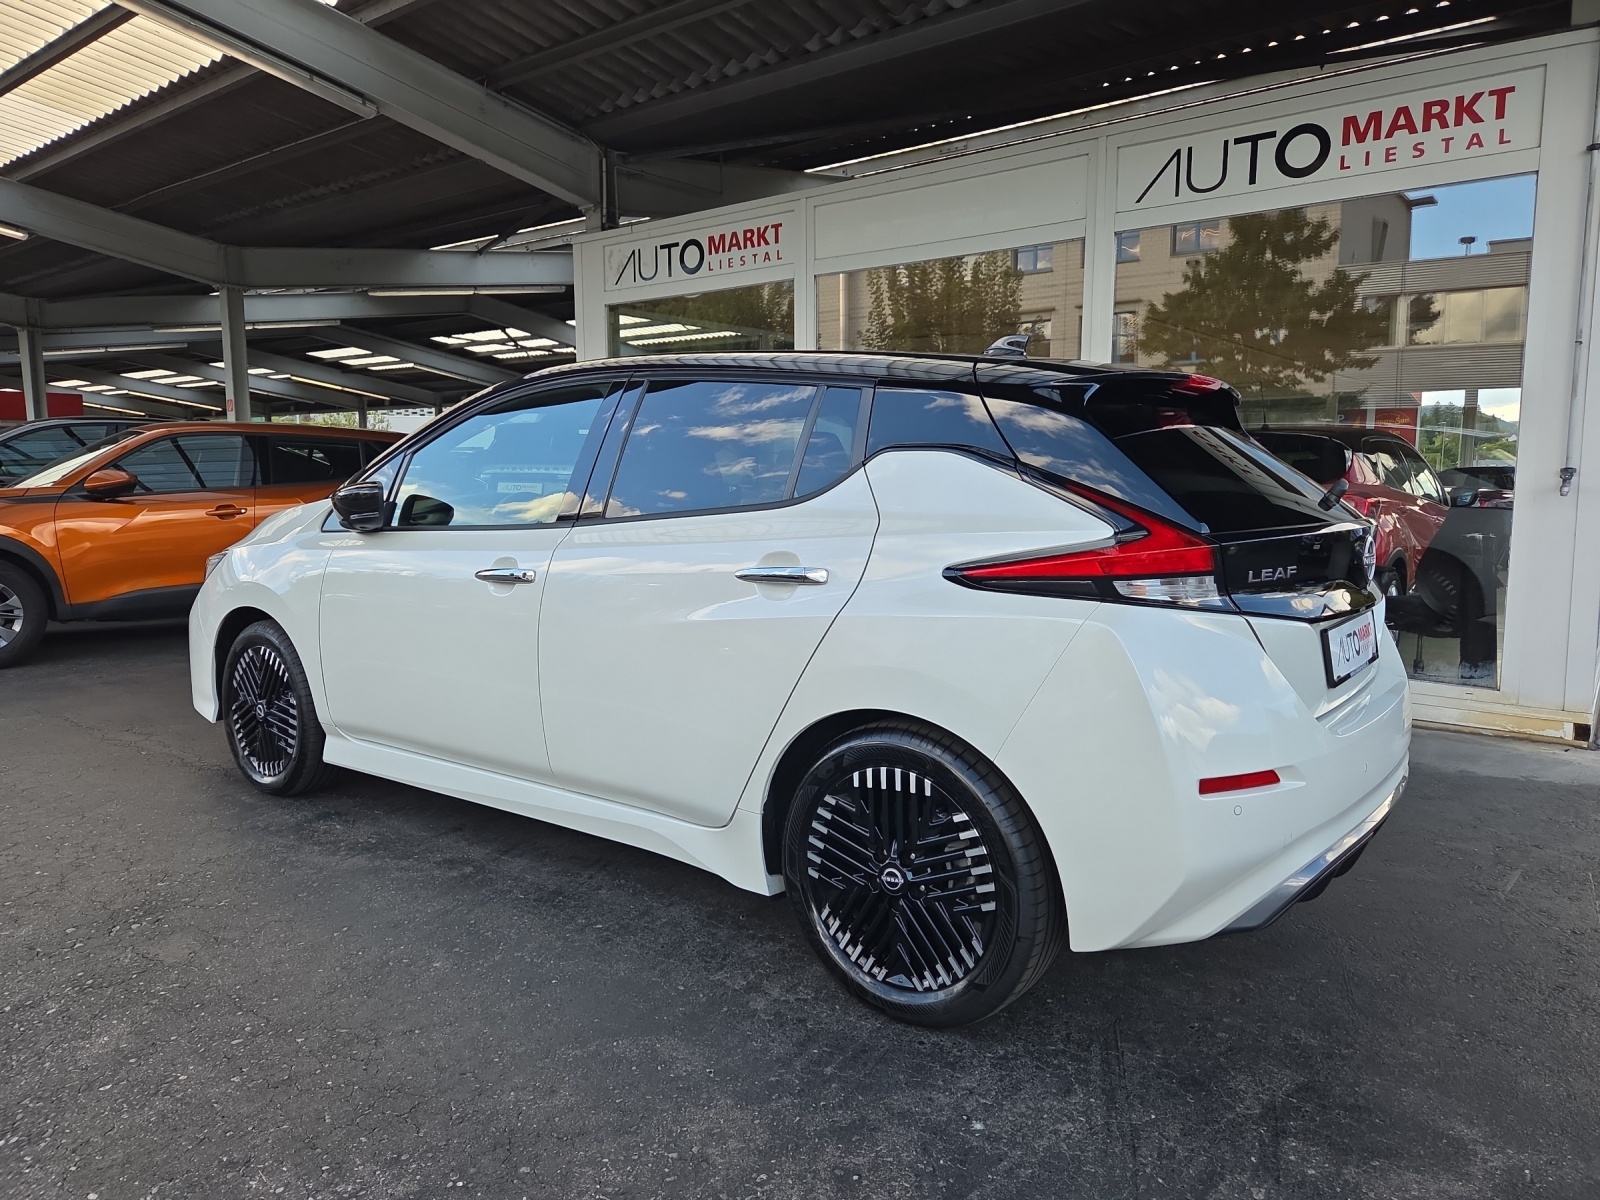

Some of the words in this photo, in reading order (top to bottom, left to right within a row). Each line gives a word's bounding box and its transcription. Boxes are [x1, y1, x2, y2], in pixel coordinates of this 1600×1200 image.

[1135, 122, 1332, 204] AUTO
[1341, 86, 1516, 147] MARKT
[1339, 129, 1512, 170] LIESTAL
[614, 238, 705, 285] AUTO
[707, 222, 783, 255] MARKT
[707, 249, 783, 271] LIESTAL
[1247, 565, 1298, 583] LEAF
[1337, 629, 1360, 667] AUTO
